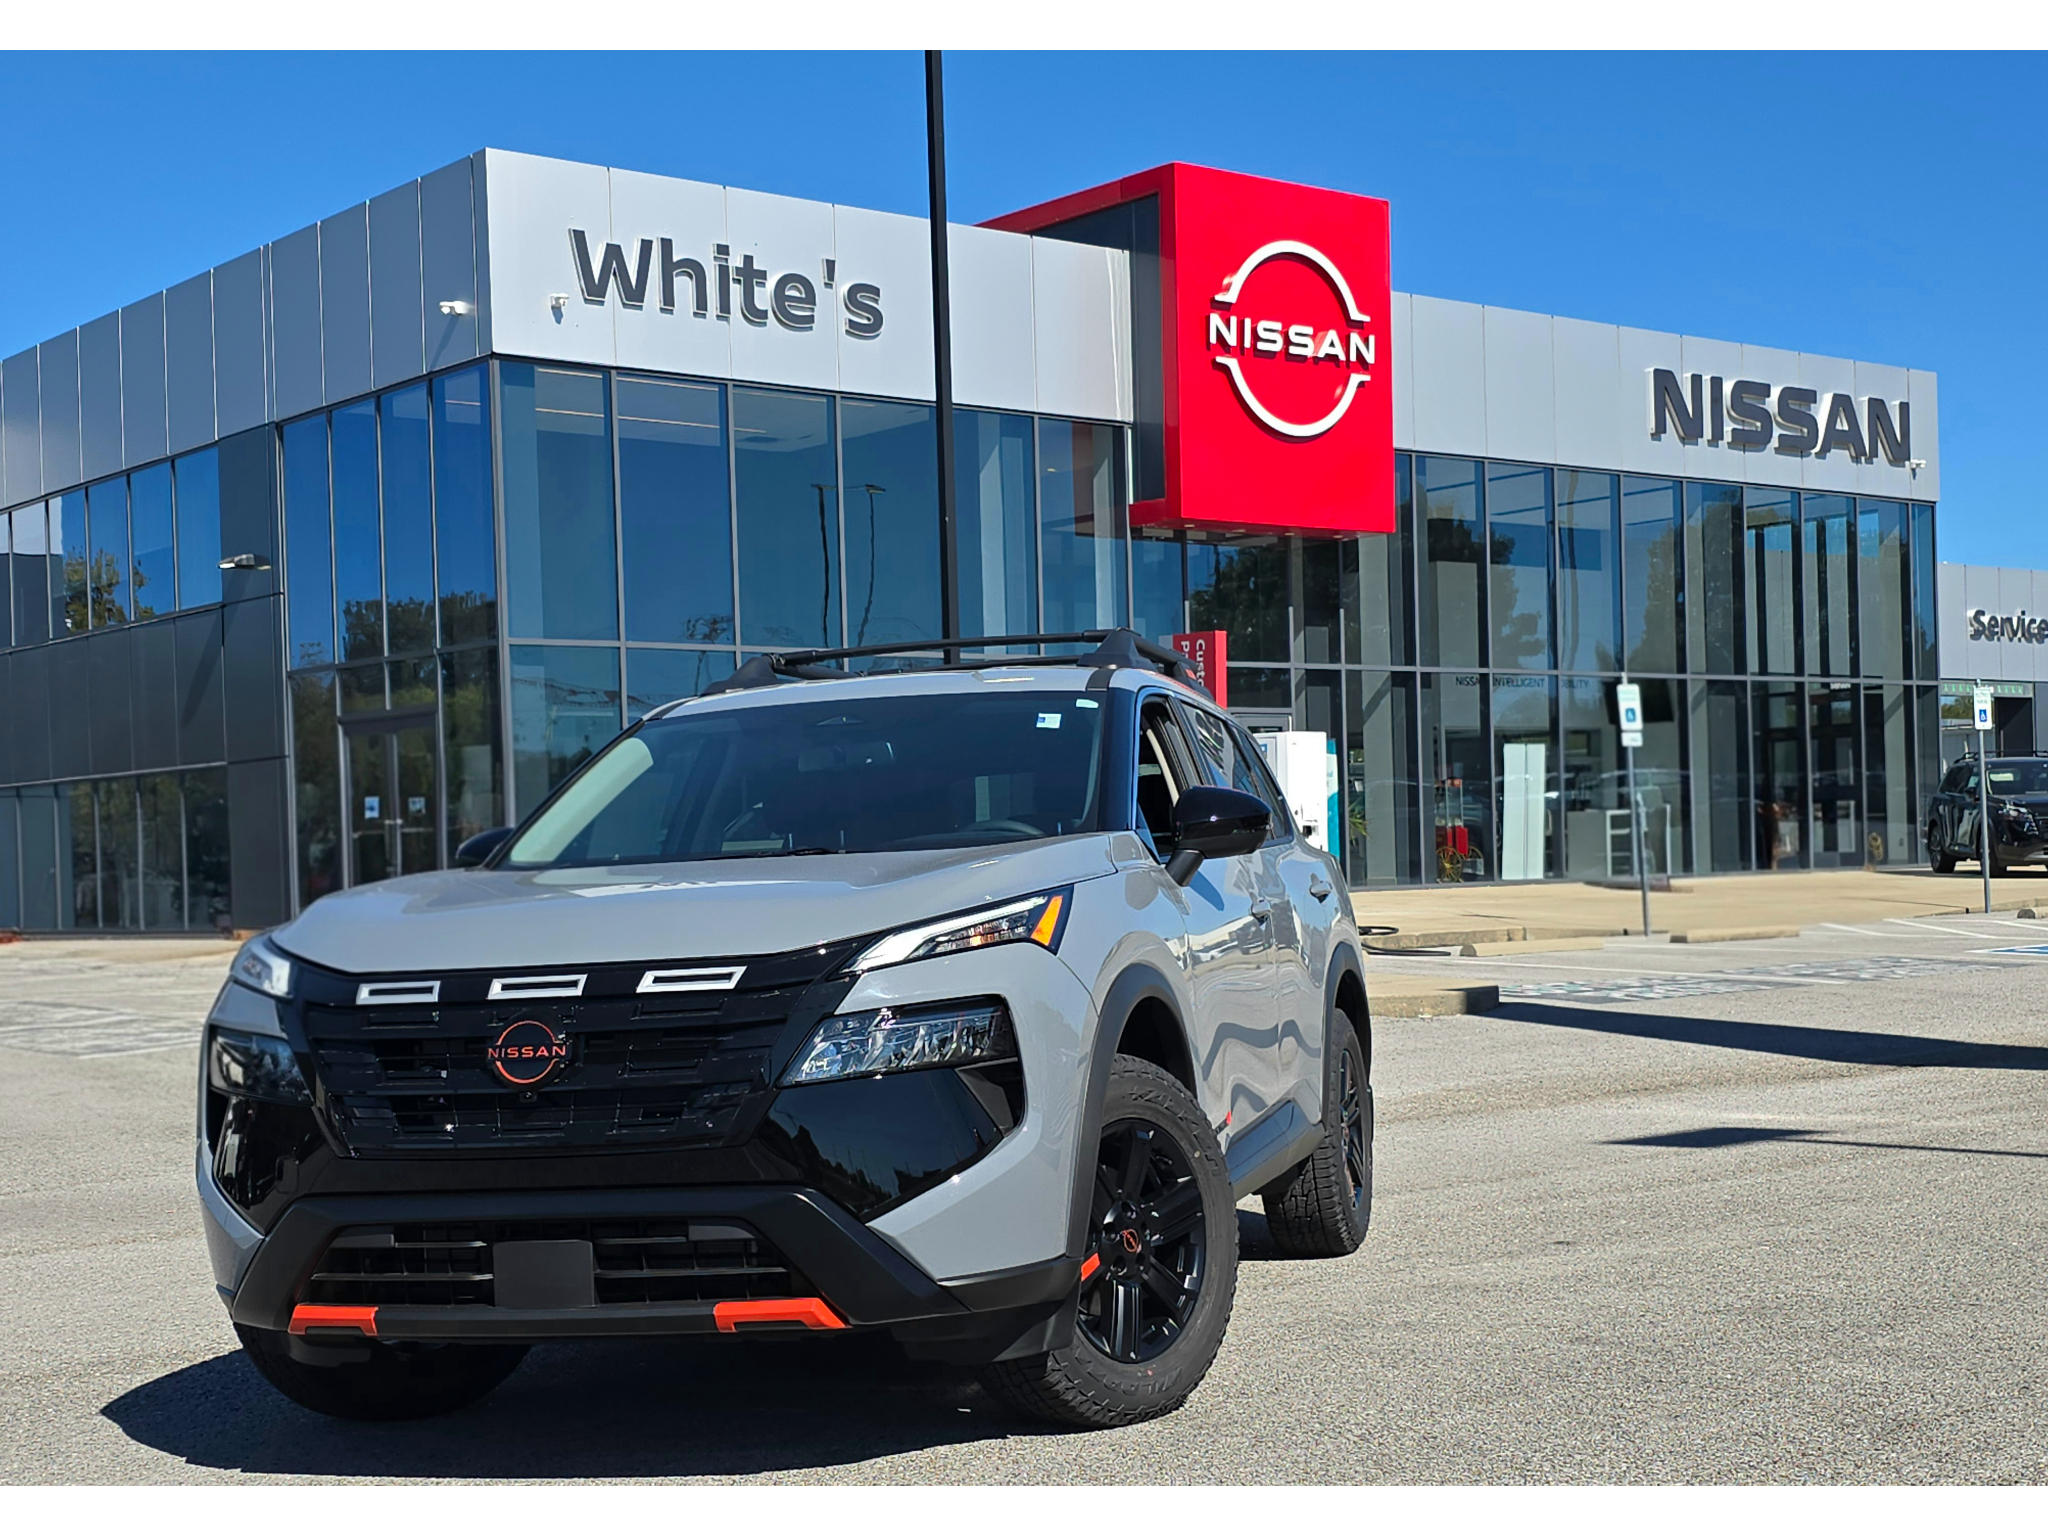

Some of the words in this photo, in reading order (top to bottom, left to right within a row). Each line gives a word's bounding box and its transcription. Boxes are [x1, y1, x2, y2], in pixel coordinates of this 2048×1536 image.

[569, 228, 884, 337] White's
[1208, 312, 1376, 365] NISSAN
[1649, 367, 1911, 463] NISSAN
[1968, 608, 2048, 642] Service
[1455, 676, 1480, 686] NISSA
[487, 1045, 566, 1059] NISSAN
